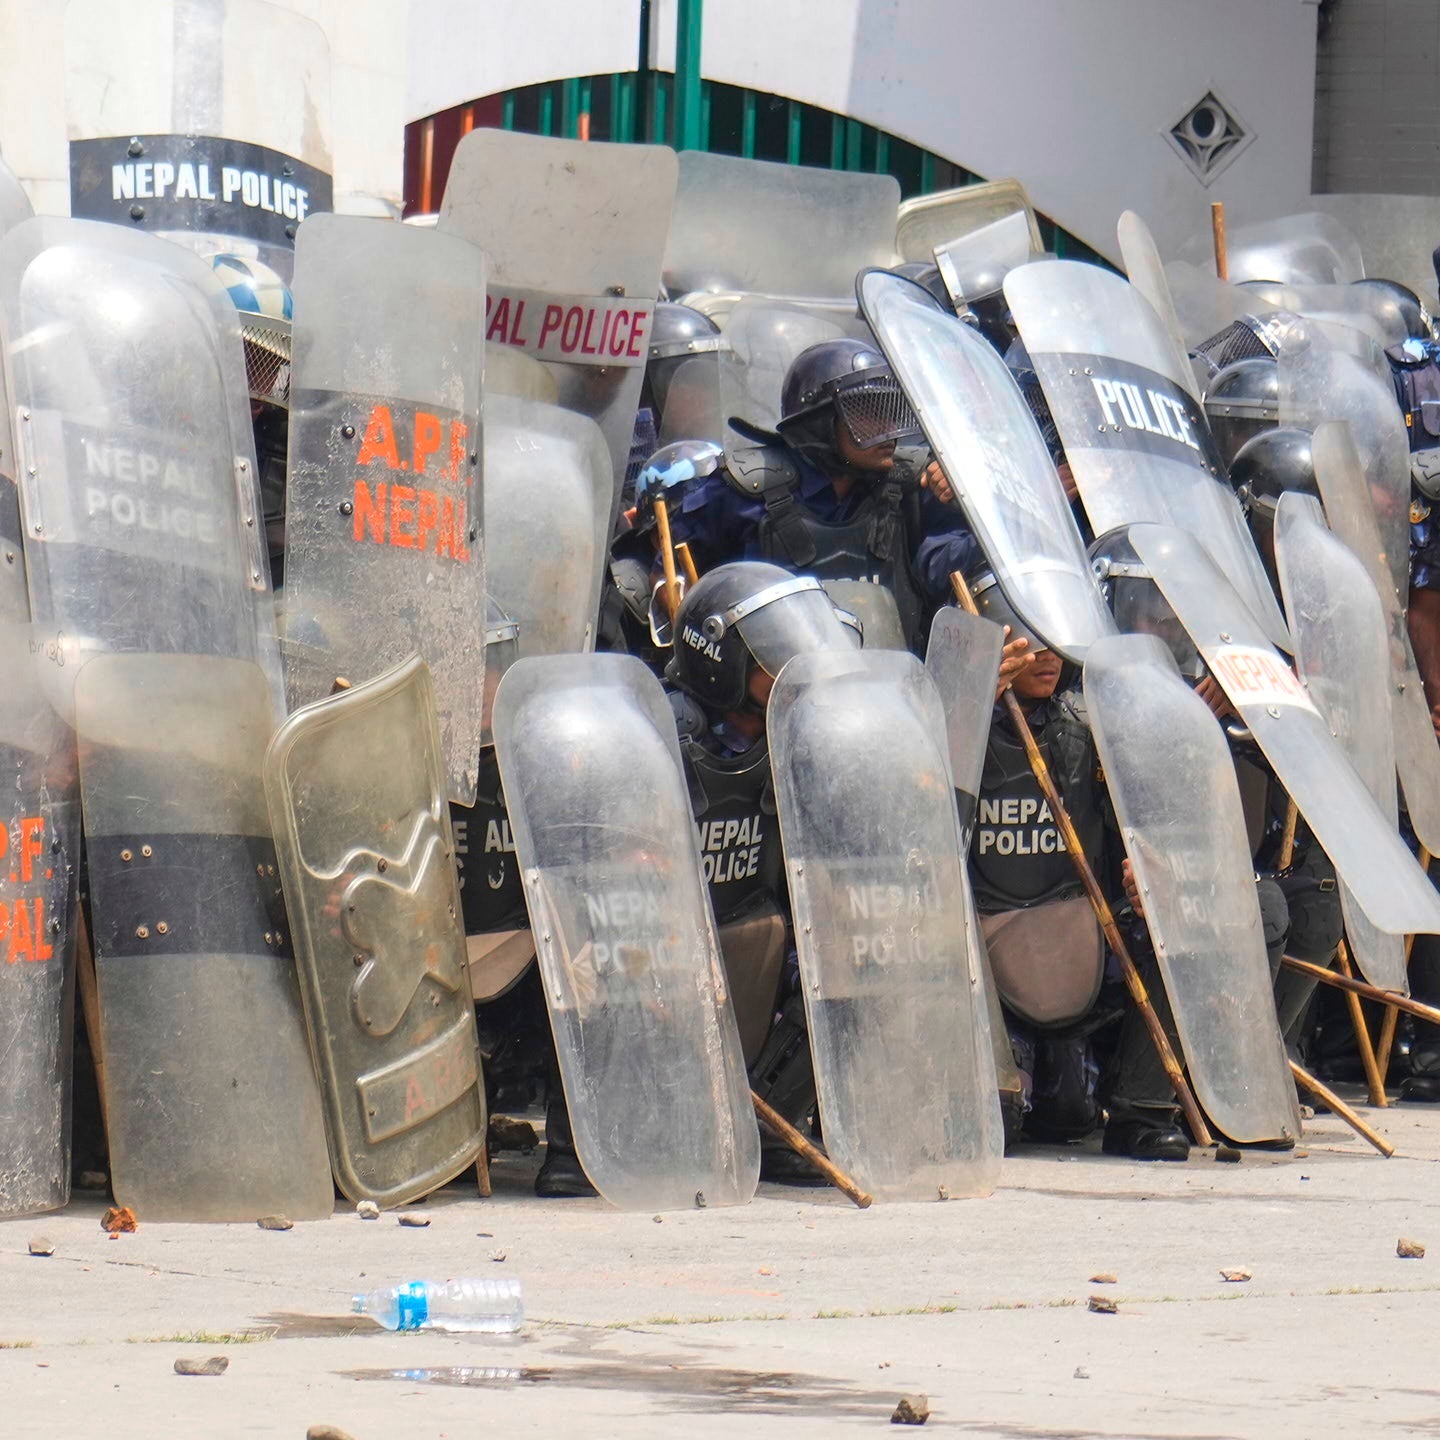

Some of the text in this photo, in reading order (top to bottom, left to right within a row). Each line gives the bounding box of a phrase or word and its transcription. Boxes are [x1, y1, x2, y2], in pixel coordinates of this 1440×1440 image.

[112, 163, 309, 223] NEPAL POLICE
[538, 304, 647, 357] POLICE
[1090, 378, 1201, 451] POLICE
[84, 440, 210, 500] NEPAL
[352, 479, 471, 564] NEPAL
[682, 625, 723, 663] NEPAL
[701, 845, 761, 884] OLICE
